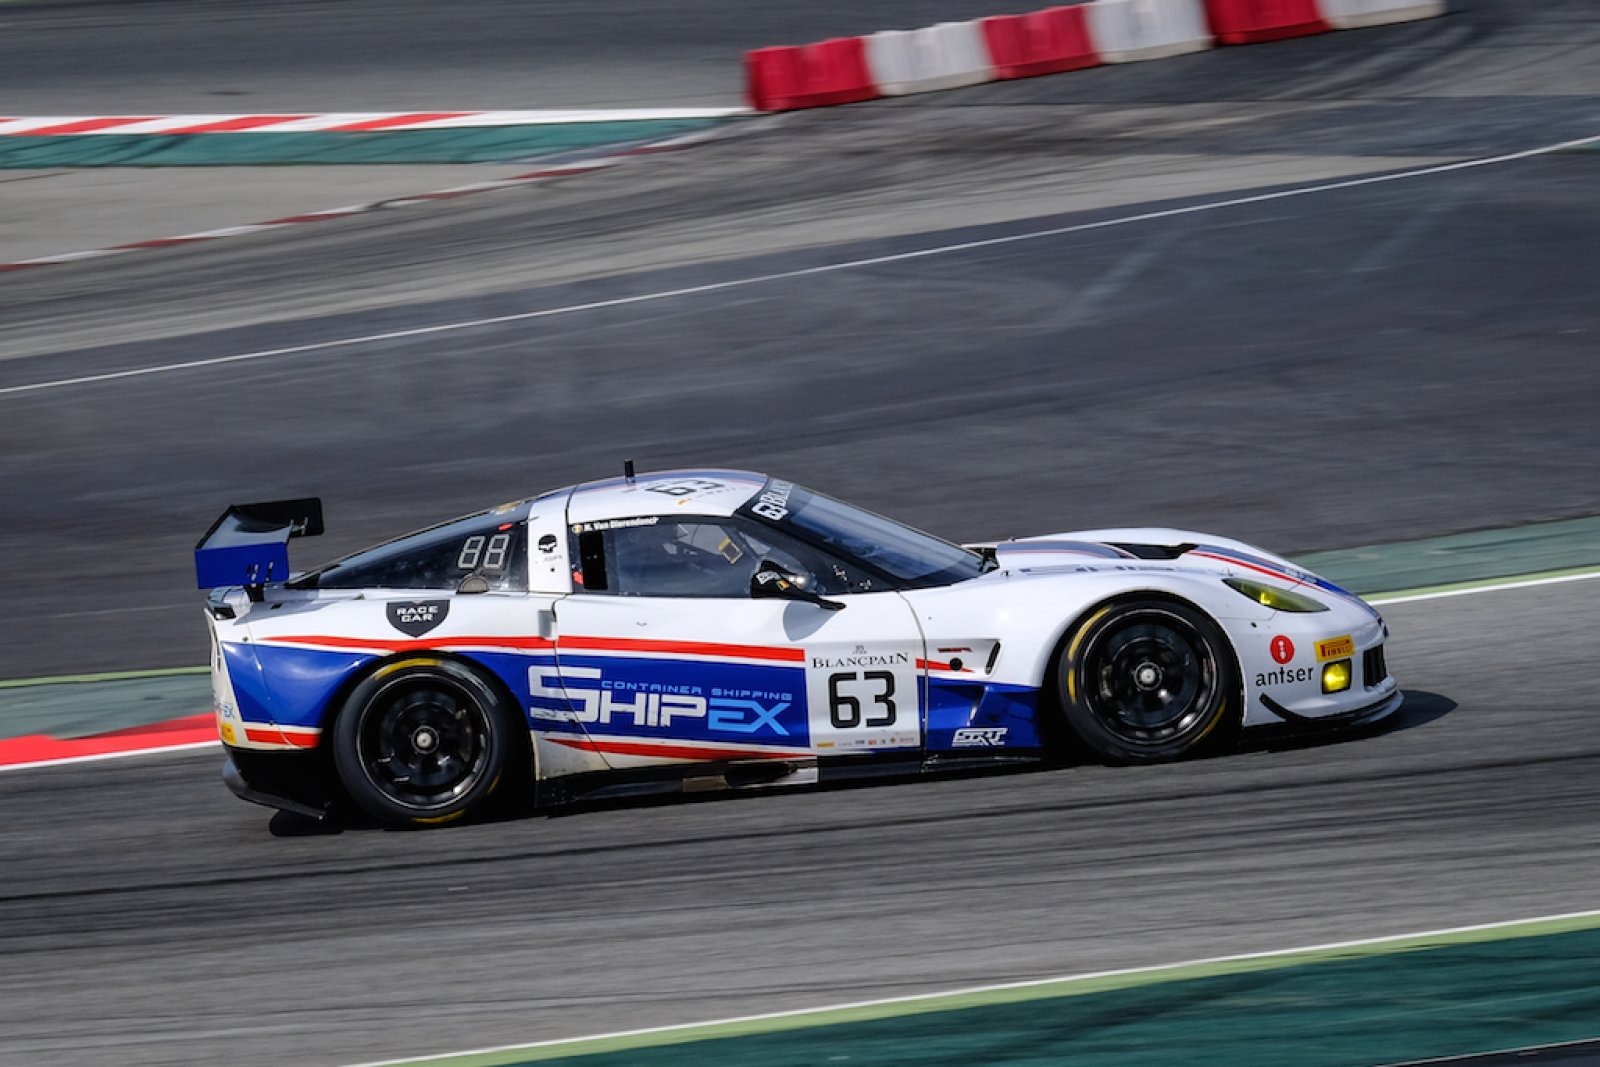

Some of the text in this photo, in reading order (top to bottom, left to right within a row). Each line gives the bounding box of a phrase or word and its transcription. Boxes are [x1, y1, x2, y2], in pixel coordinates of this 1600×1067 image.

[457, 533, 510, 569] 88
[396, 605, 438, 616] RACE
[401, 613, 433, 623] CAR
[812, 652, 909, 669] BLANCPAIN
[1255, 666, 1315, 687] antser
[527, 665, 791, 736] SHIPEX
[601, 680, 793, 701] CONTAINER SHIPPING
[828, 670, 896, 729] 63
